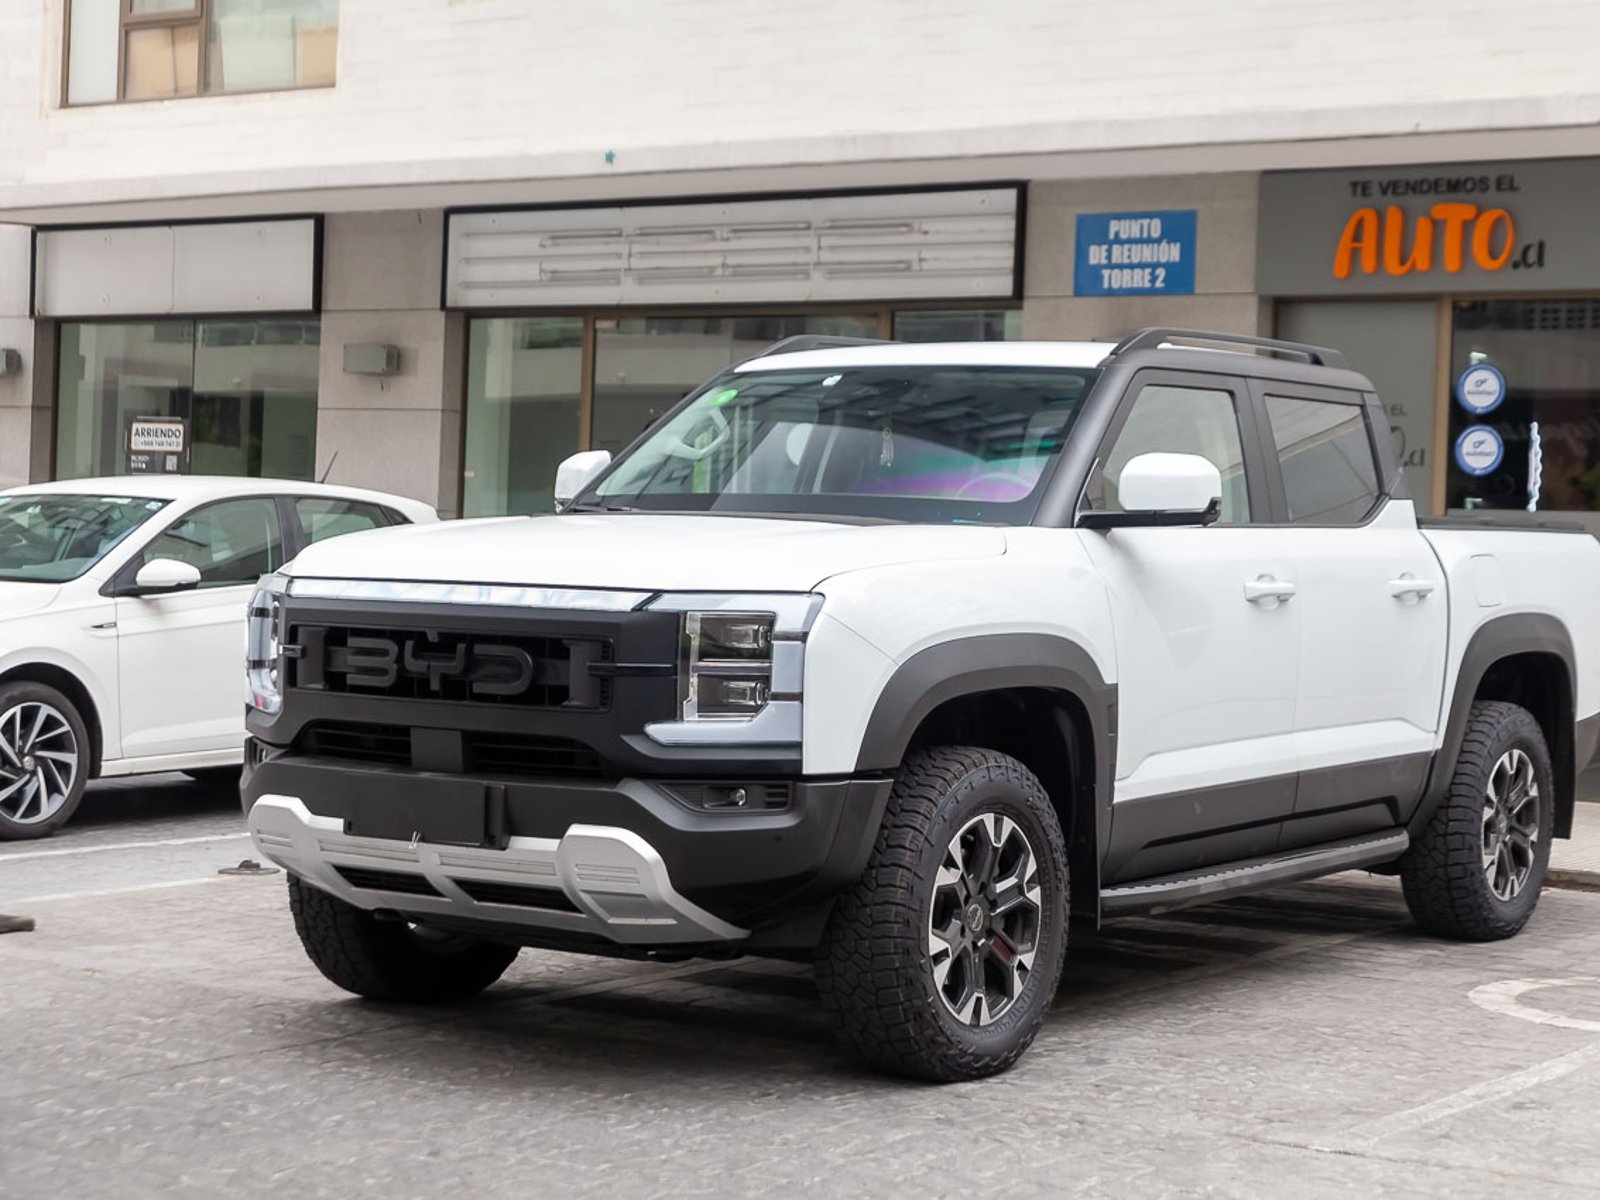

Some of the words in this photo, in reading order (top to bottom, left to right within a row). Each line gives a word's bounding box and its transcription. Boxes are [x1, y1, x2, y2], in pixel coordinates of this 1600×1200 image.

[1350, 181, 1372, 197] TE
[1379, 176, 1490, 196] VENDEMOS
[1496, 175, 1520, 191] EL
[1109, 218, 1162, 239] PUNTO
[1088, 245, 1109, 264] DE
[1111, 239, 1180, 263] REUNIÓN
[1102, 268, 1152, 288] TORRE
[1154, 267, 1166, 288] 2
[134, 428, 181, 439] ARRIENDO
[346, 628, 533, 696] BYD
